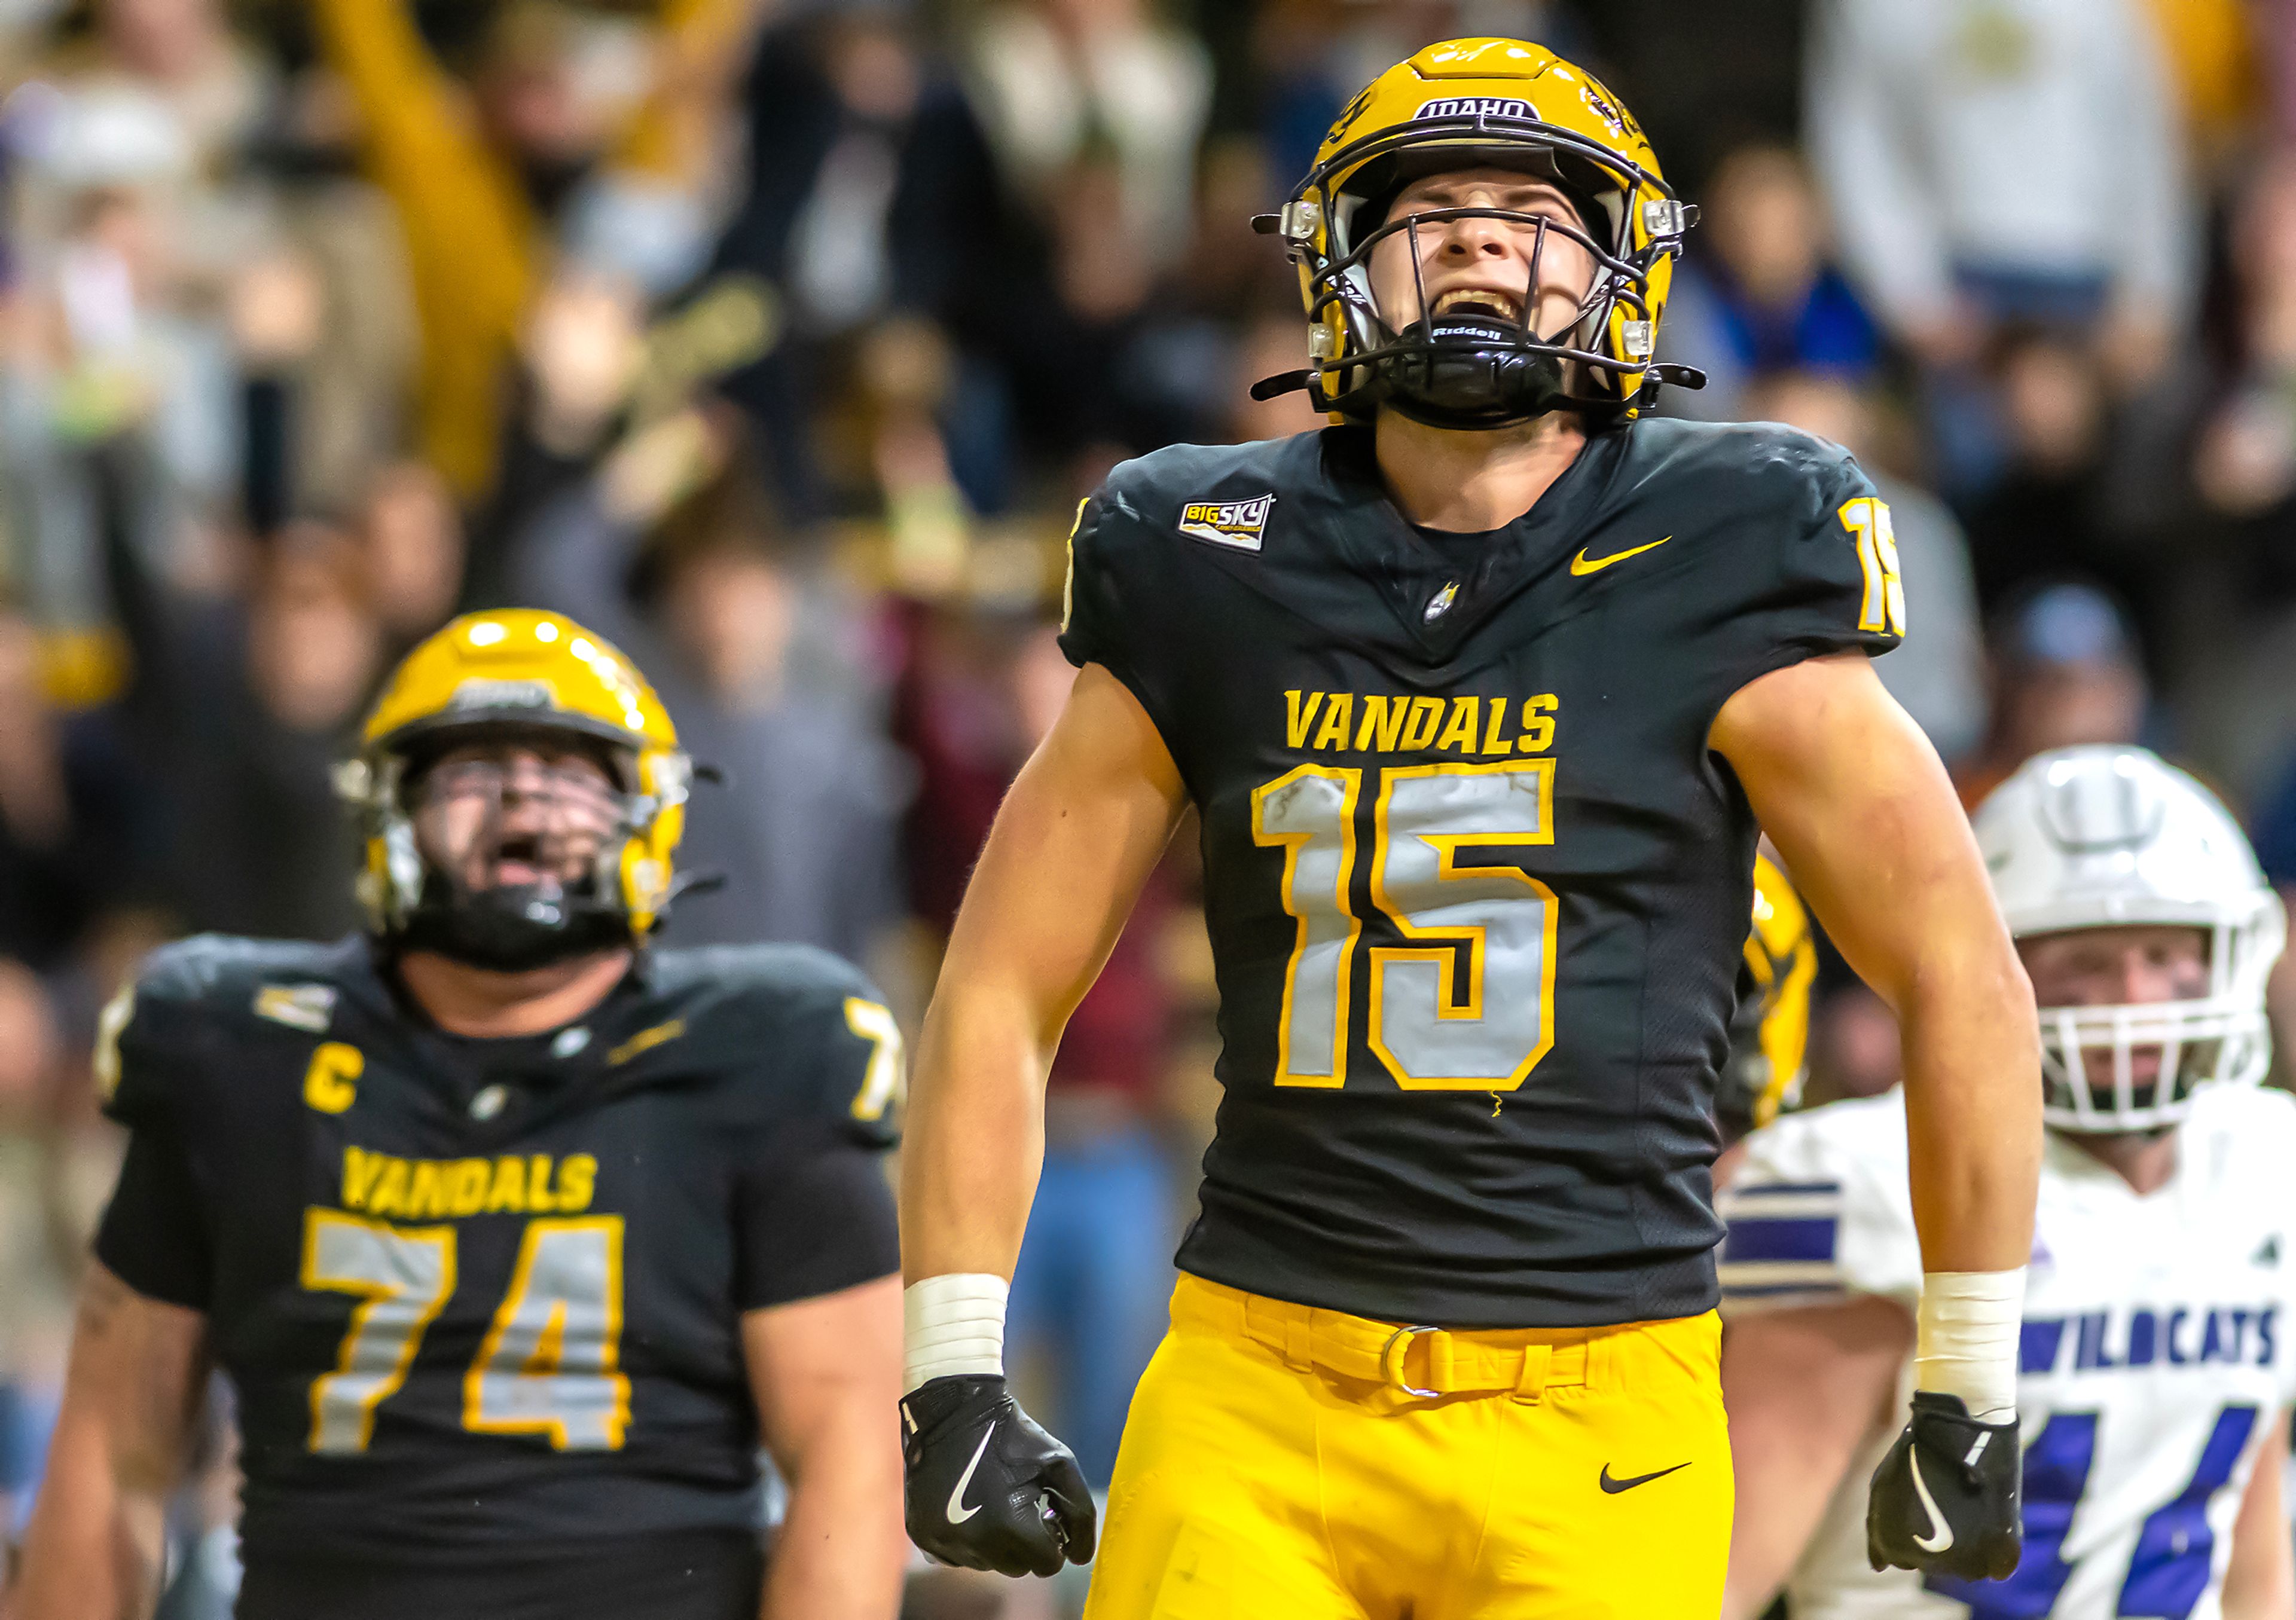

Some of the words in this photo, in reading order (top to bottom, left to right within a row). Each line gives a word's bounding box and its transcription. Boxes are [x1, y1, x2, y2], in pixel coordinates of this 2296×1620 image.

[1428, 99, 1526, 118] IDAHO
[1433, 326, 1501, 341] Riddell
[1284, 689, 1559, 755] VANDALS
[1251, 757, 1559, 1092] 15
[303, 1041, 365, 1115] C
[343, 1145, 597, 1219] VANDALS
[300, 1204, 633, 1454] 74
